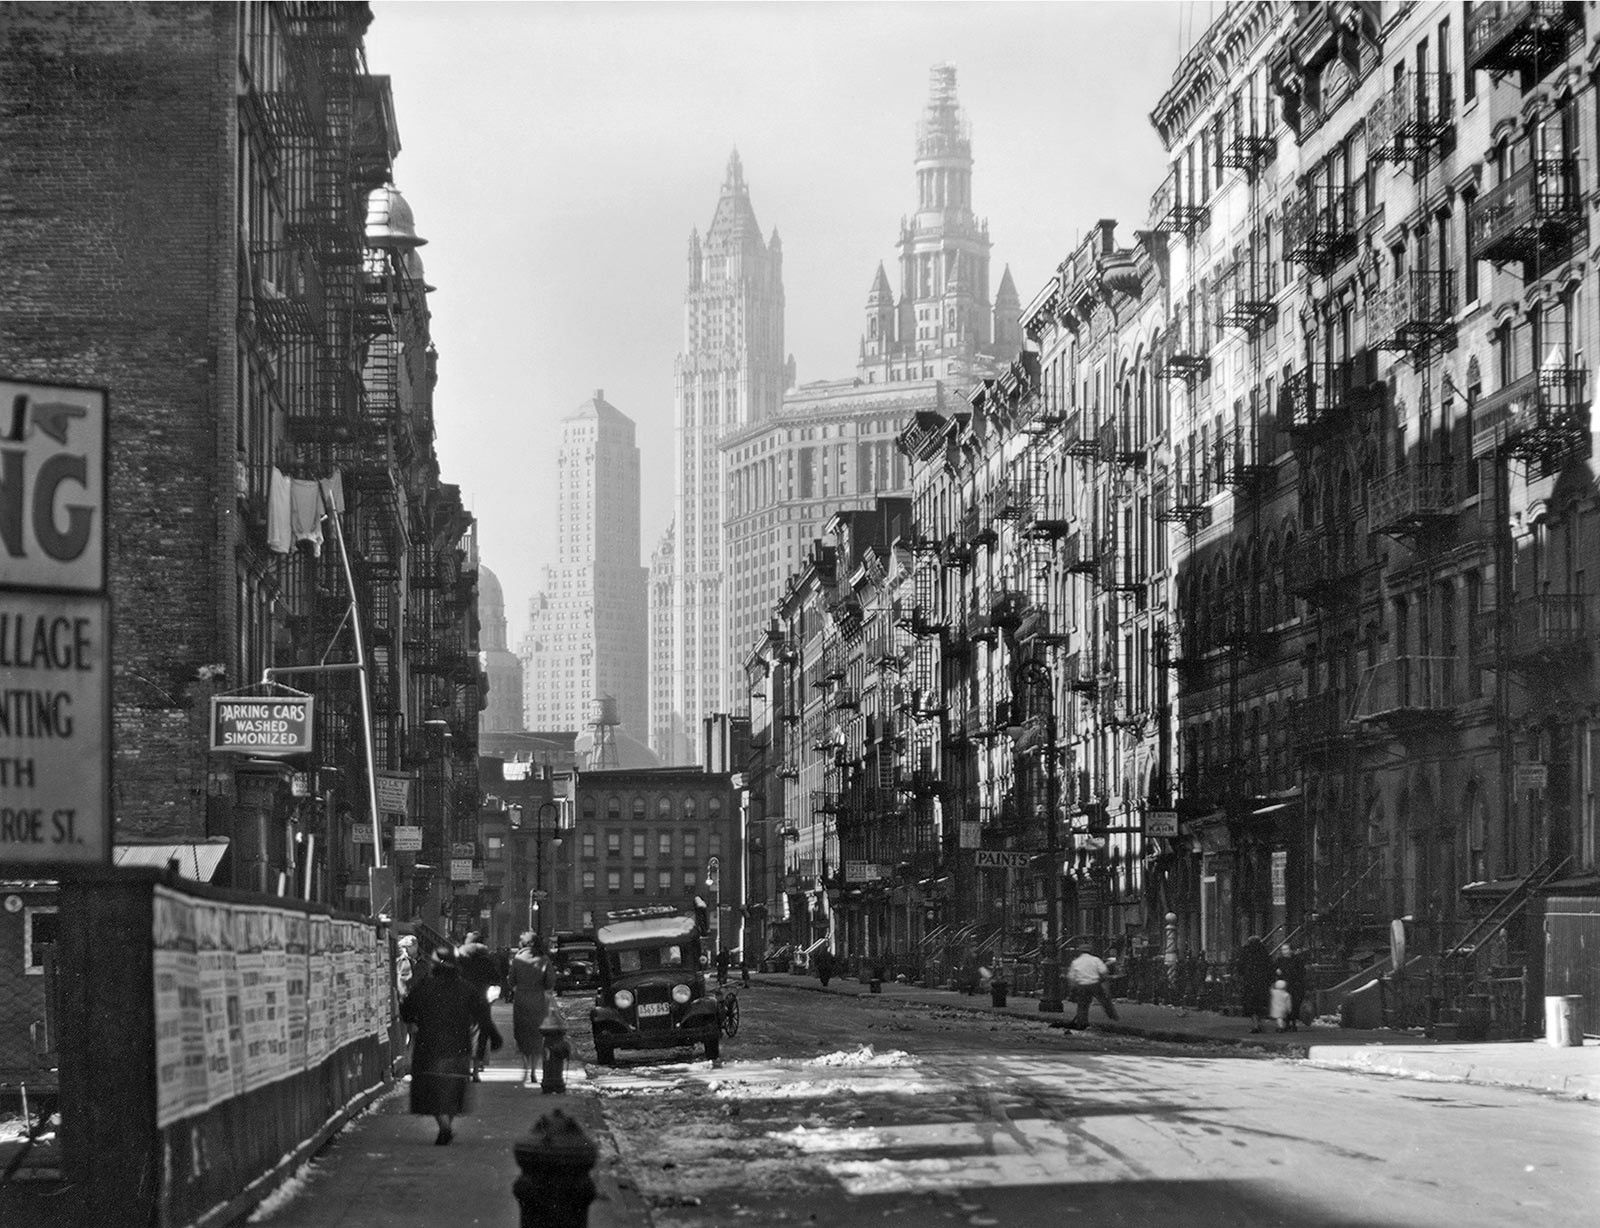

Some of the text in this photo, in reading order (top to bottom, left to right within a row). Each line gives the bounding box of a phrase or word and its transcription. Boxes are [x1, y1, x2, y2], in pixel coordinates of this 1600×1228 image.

[0, 613, 92, 672] LLAGE
[219, 704, 305, 723] PARKING CARS
[235, 720, 288, 732] WASHED
[224, 732, 297, 745] SIMONIZED
[51, 808, 84, 846] ST.
[978, 852, 1028, 866] PAINTS
